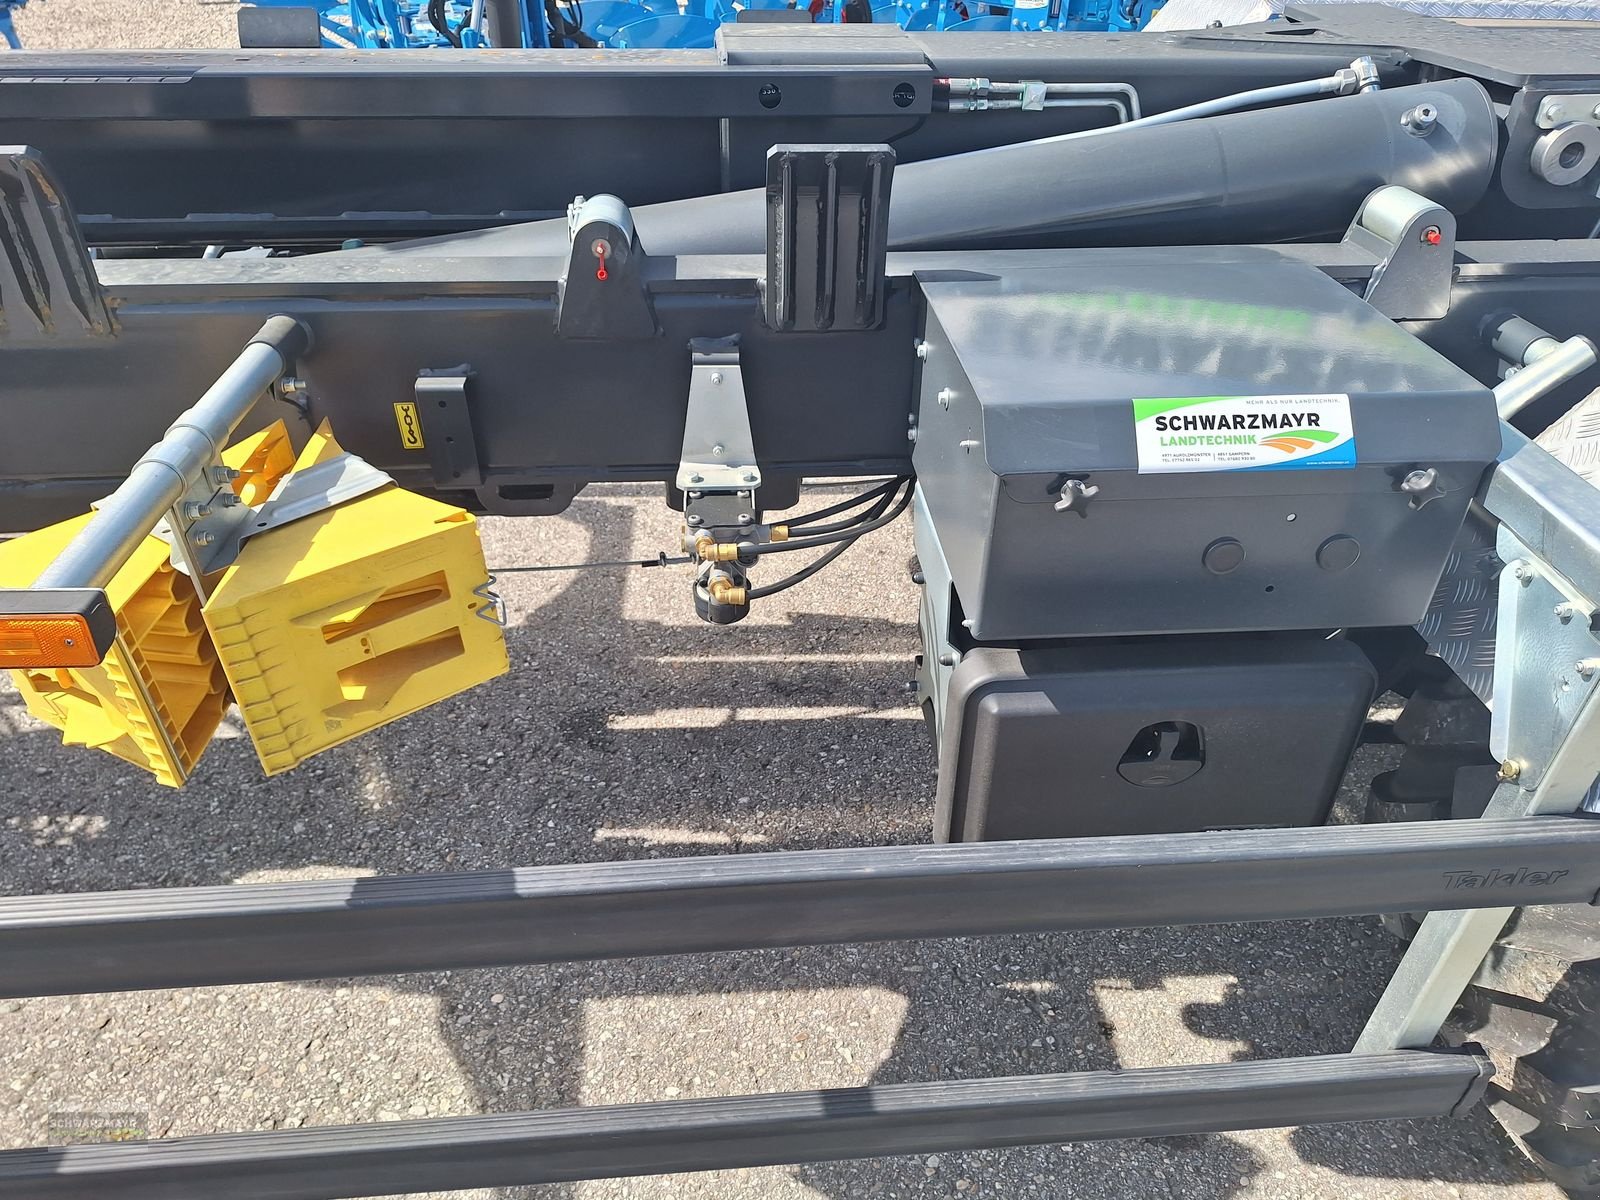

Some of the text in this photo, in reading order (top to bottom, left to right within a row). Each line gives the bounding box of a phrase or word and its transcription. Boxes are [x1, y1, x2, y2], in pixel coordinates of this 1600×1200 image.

[1155, 412, 1321, 432] SCHWARZMAYR
[1160, 434, 1257, 447] LANDTECHNIK
[1442, 867, 1570, 889] Takler
